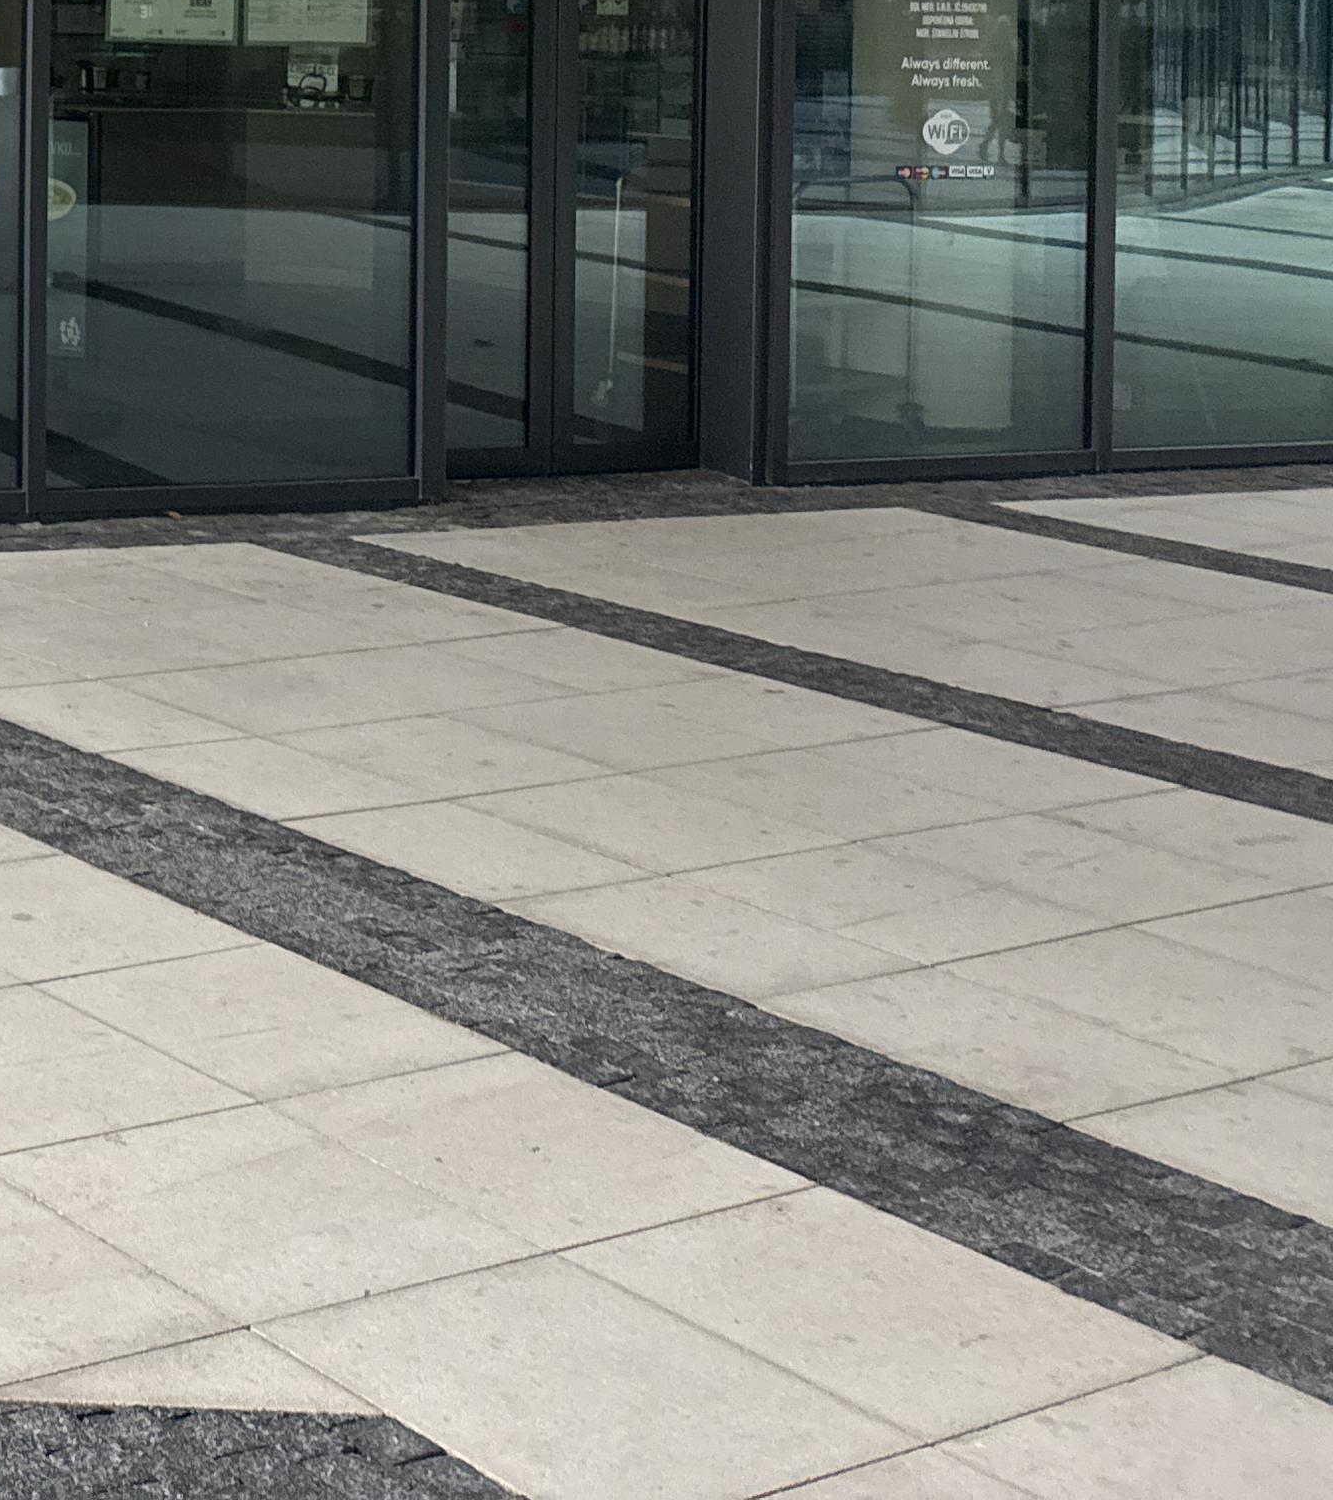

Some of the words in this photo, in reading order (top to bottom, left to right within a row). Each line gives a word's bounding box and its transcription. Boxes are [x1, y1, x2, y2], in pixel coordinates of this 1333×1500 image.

[901, 56, 941, 72] Always
[942, 56, 991, 71] different.
[911, 73, 950, 90] Always
[952, 74, 982, 88] fresh.
